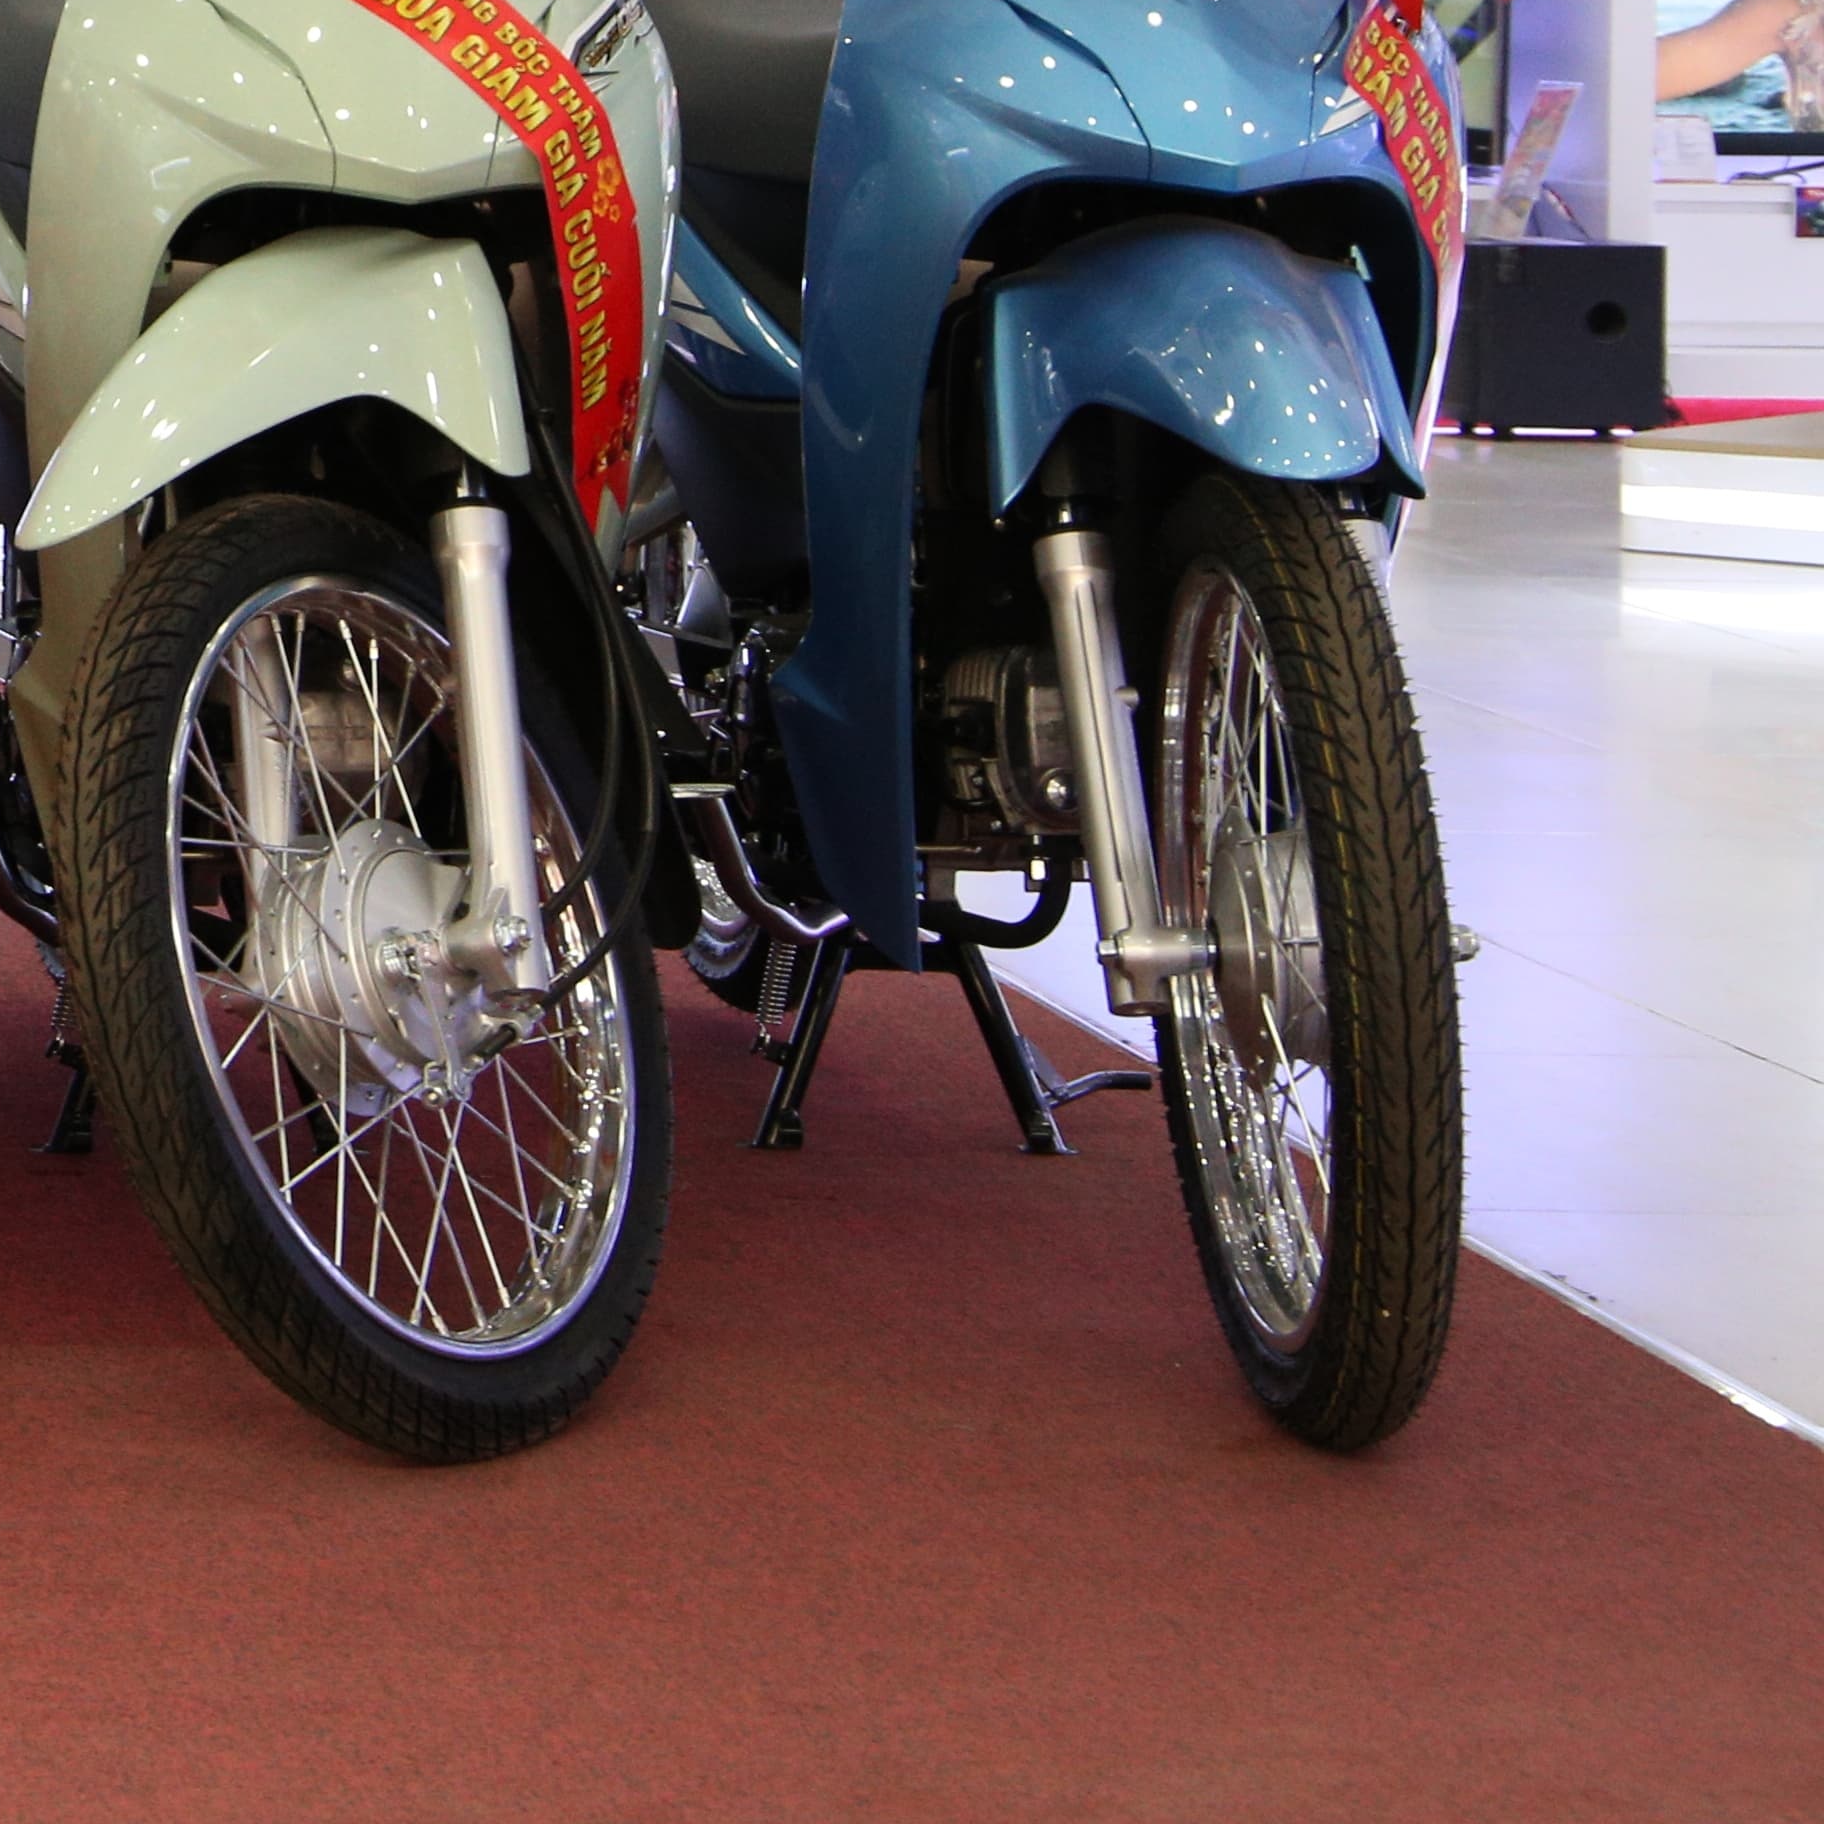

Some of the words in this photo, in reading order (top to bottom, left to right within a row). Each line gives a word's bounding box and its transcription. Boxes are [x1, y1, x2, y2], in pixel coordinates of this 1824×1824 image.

[450, 32, 554, 134] GIẢM
[493, 20, 552, 78] BỐC
[548, 74, 603, 162] THĂM
[1364, 19, 1412, 79] BỐC
[543, 131, 590, 209] GIÁ
[1400, 134, 1442, 213] GIÁ
[563, 210, 612, 312] CUỐI
[578, 317, 615, 411] NĂM
